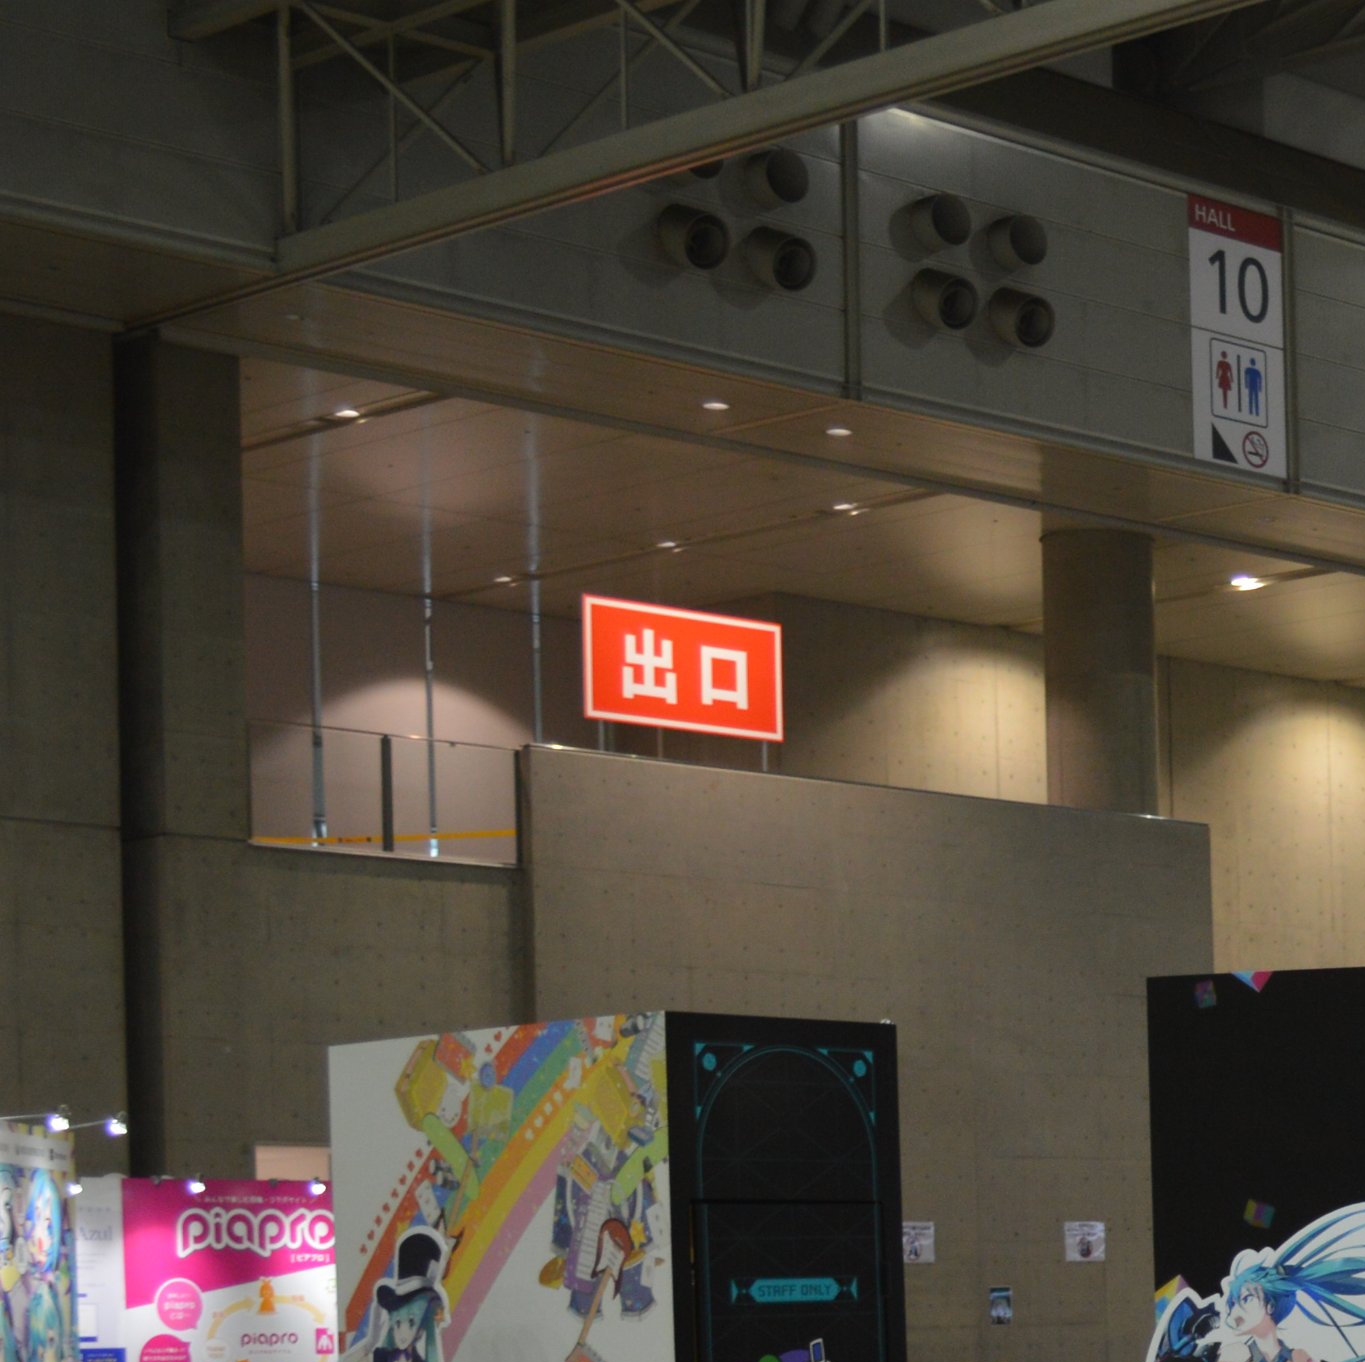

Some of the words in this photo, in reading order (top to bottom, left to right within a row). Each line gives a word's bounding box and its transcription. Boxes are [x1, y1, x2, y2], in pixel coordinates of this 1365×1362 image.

[1194, 203, 1237, 233] HALL
[1208, 249, 1270, 325] 10
[622, 628, 749, 711] 出口
[176, 1205, 335, 1259] piapro
[757, 1284, 796, 1298] STAFF
[800, 1283, 833, 1297] ONLY
[240, 1332, 298, 1348] piapro
